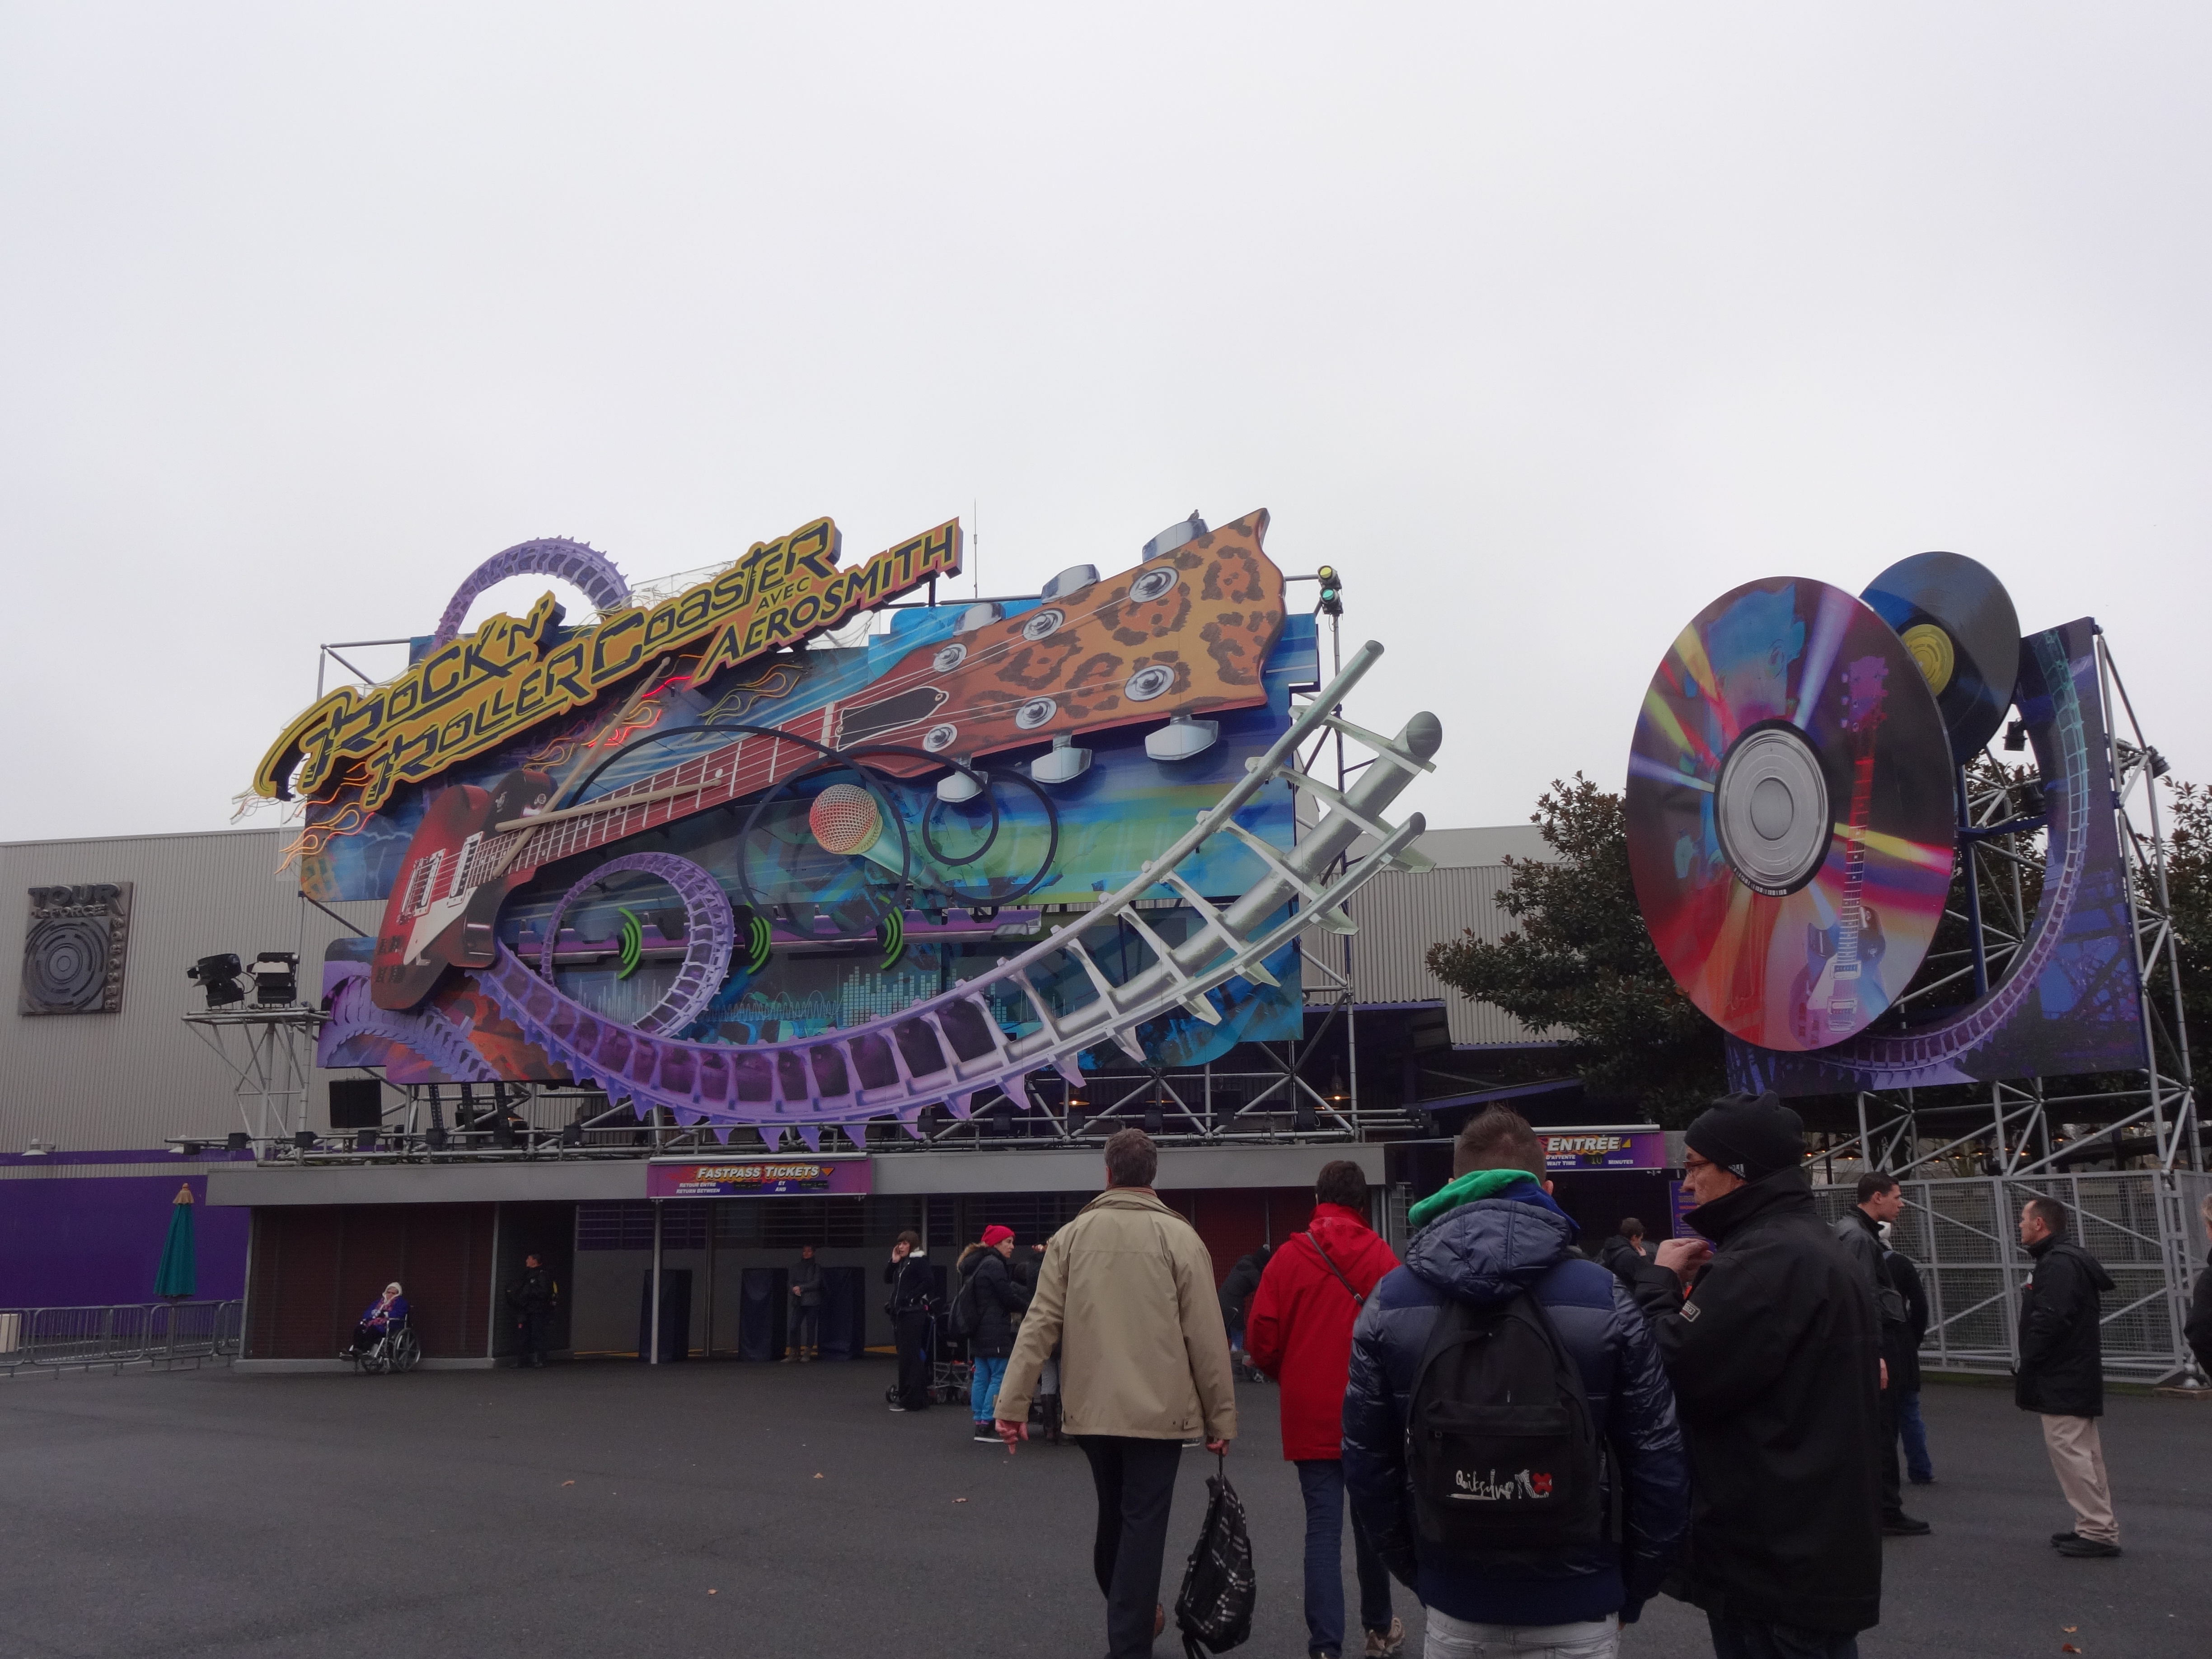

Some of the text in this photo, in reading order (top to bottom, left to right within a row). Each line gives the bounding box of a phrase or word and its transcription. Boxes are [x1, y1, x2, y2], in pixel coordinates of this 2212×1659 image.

[697, 524, 953, 679] AEROSMITH
[755, 576, 811, 614] AVEC
[28, 883, 126, 915] TOUR
[697, 1166, 819, 1178] FASTPASS TICKETS
